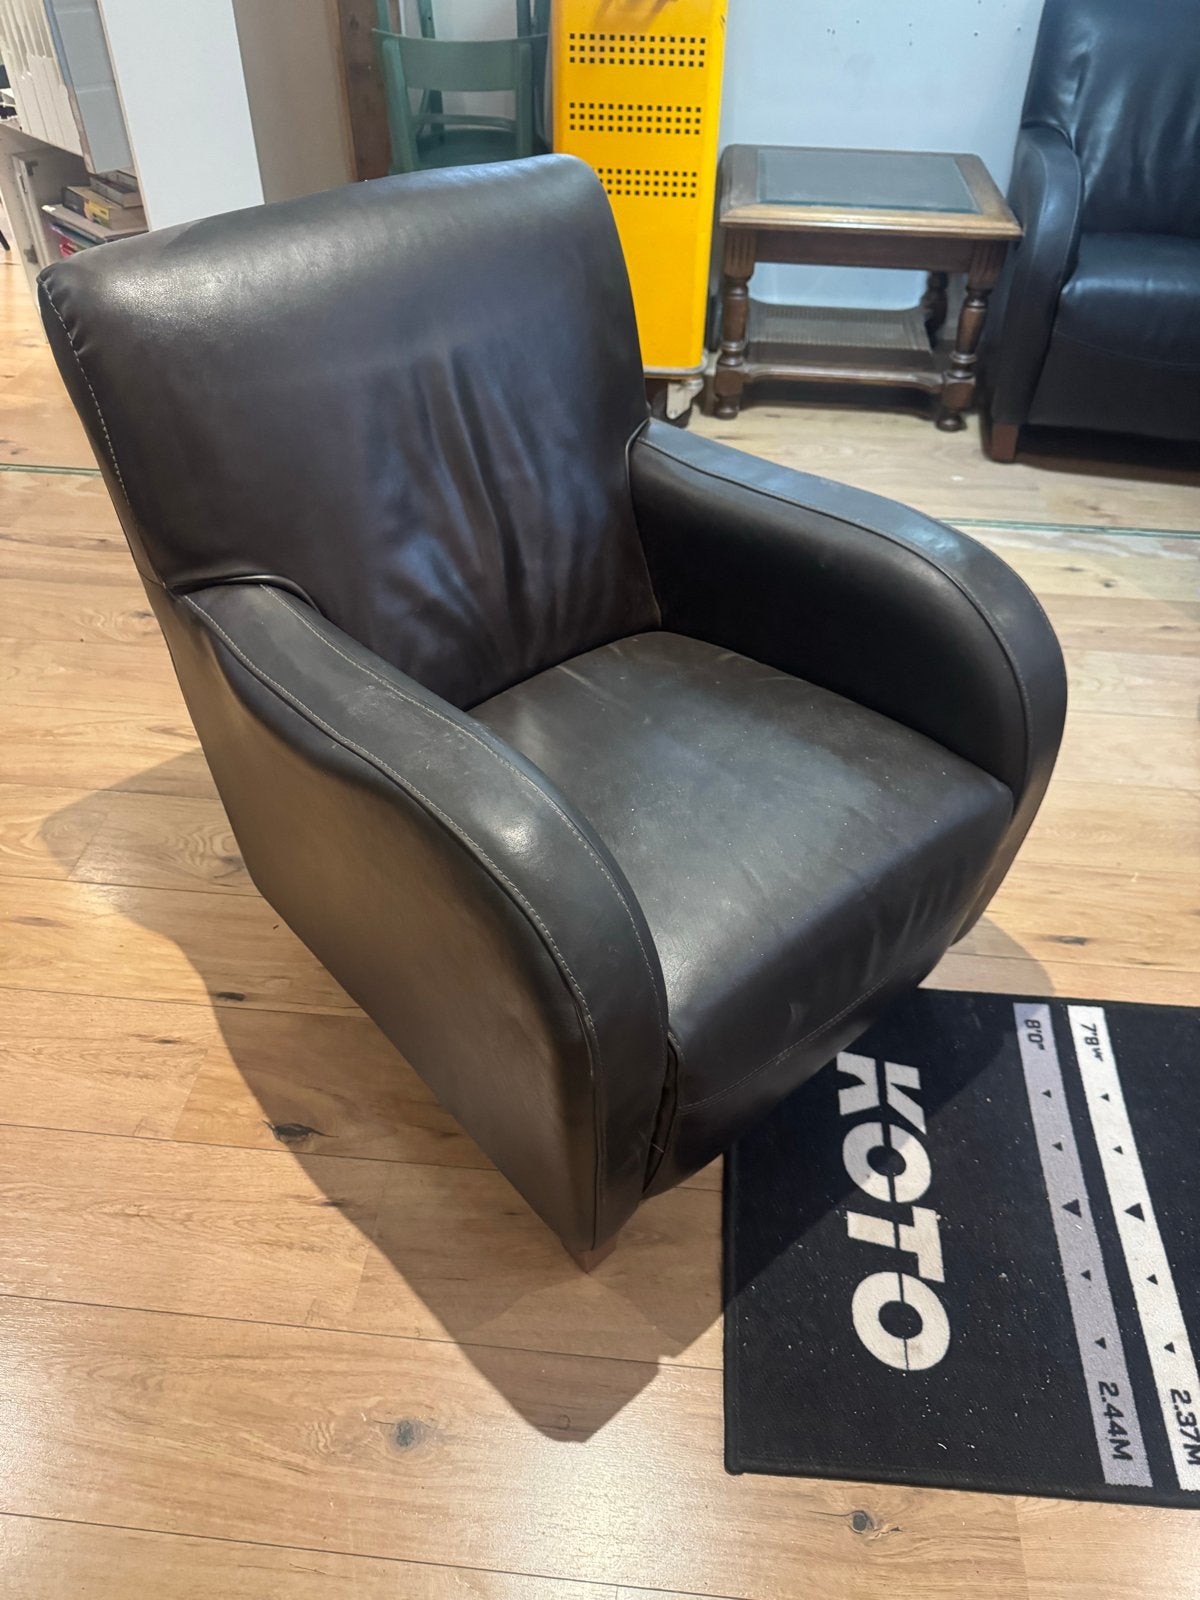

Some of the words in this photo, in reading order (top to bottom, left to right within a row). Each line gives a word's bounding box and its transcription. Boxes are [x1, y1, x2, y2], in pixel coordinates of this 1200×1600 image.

[836, 1051, 951, 1371] KOTO
[1098, 1381, 1133, 1460] 2.44M
[1170, 1388, 1200, 1465] 2.37M
